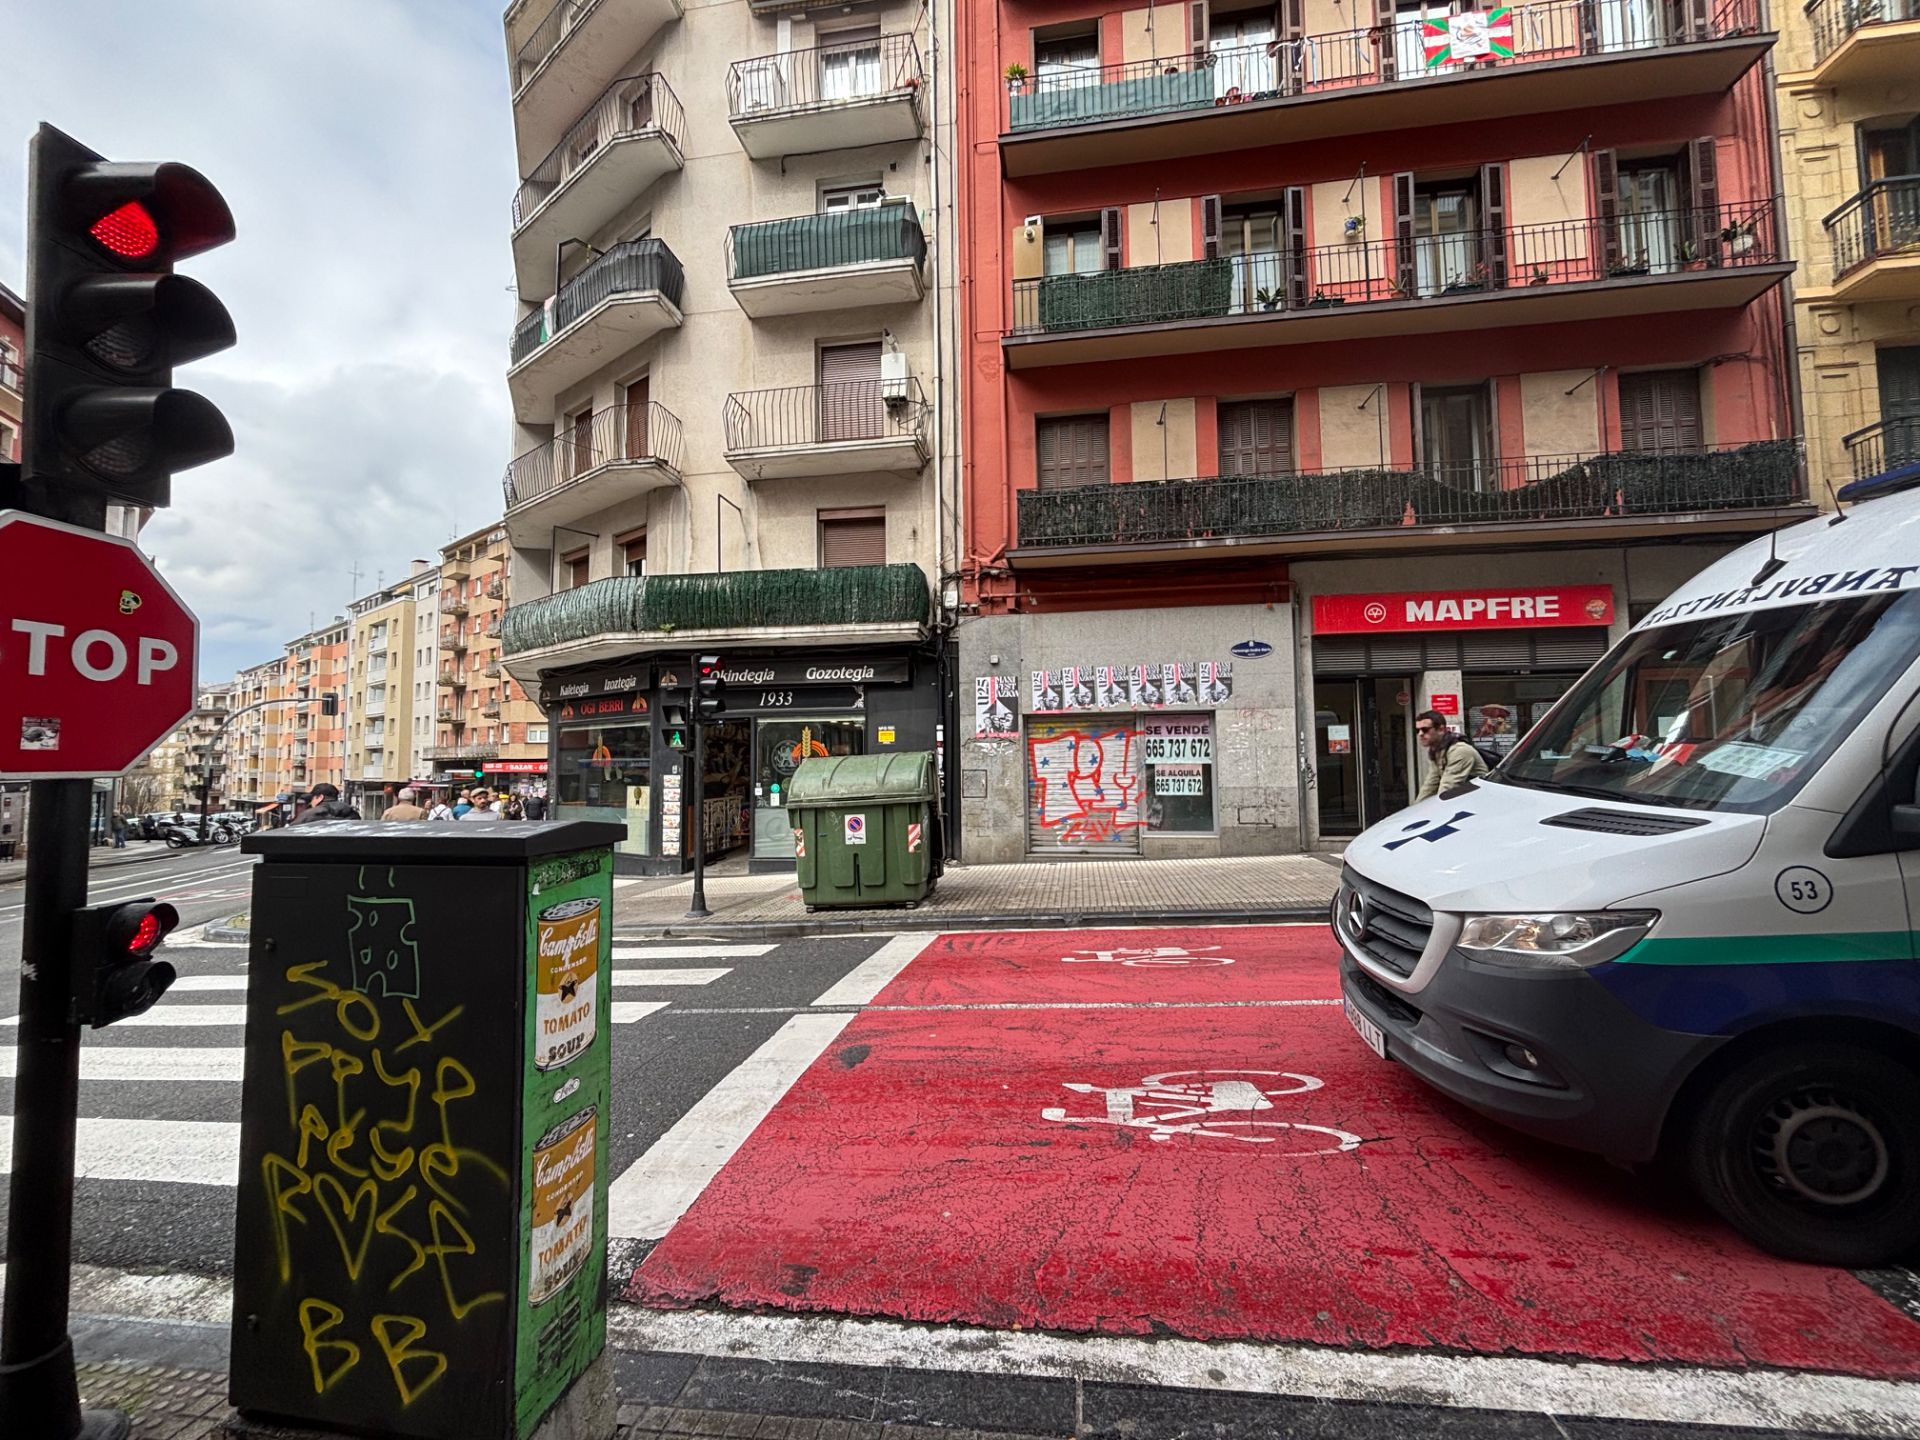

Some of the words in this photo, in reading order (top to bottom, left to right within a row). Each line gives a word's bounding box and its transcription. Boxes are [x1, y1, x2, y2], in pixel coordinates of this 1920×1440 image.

[1405, 595, 1560, 623] MAPFRE
[0, 618, 178, 686] TOP
[710, 668, 775, 685] Okindegia
[806, 665, 875, 682] Gozotegia
[560, 682, 589, 697] Kafetegia
[604, 674, 637, 691] Izoztegia
[580, 702, 595, 715] OGI
[598, 699, 624, 713] BERRI
[759, 691, 793, 706] 1933
[1145, 725, 1161, 735] SE
[1166, 725, 1209, 735] VENDE
[1146, 738, 1164, 758] 665
[1168, 738, 1187, 758] 737
[1191, 738, 1210, 758] 672
[1156, 769, 1166, 777] SE
[1168, 769, 1201, 777] ALQUILA
[1156, 779, 1170, 792] 665
[1172, 779, 1185, 792] 737
[1188, 779, 1202, 792] 672
[1790, 880, 1818, 901] 53
[543, 1002, 592, 1036] TOMATO
[548, 1032, 586, 1062] SOUP
[538, 1214, 588, 1266] TOMATO
